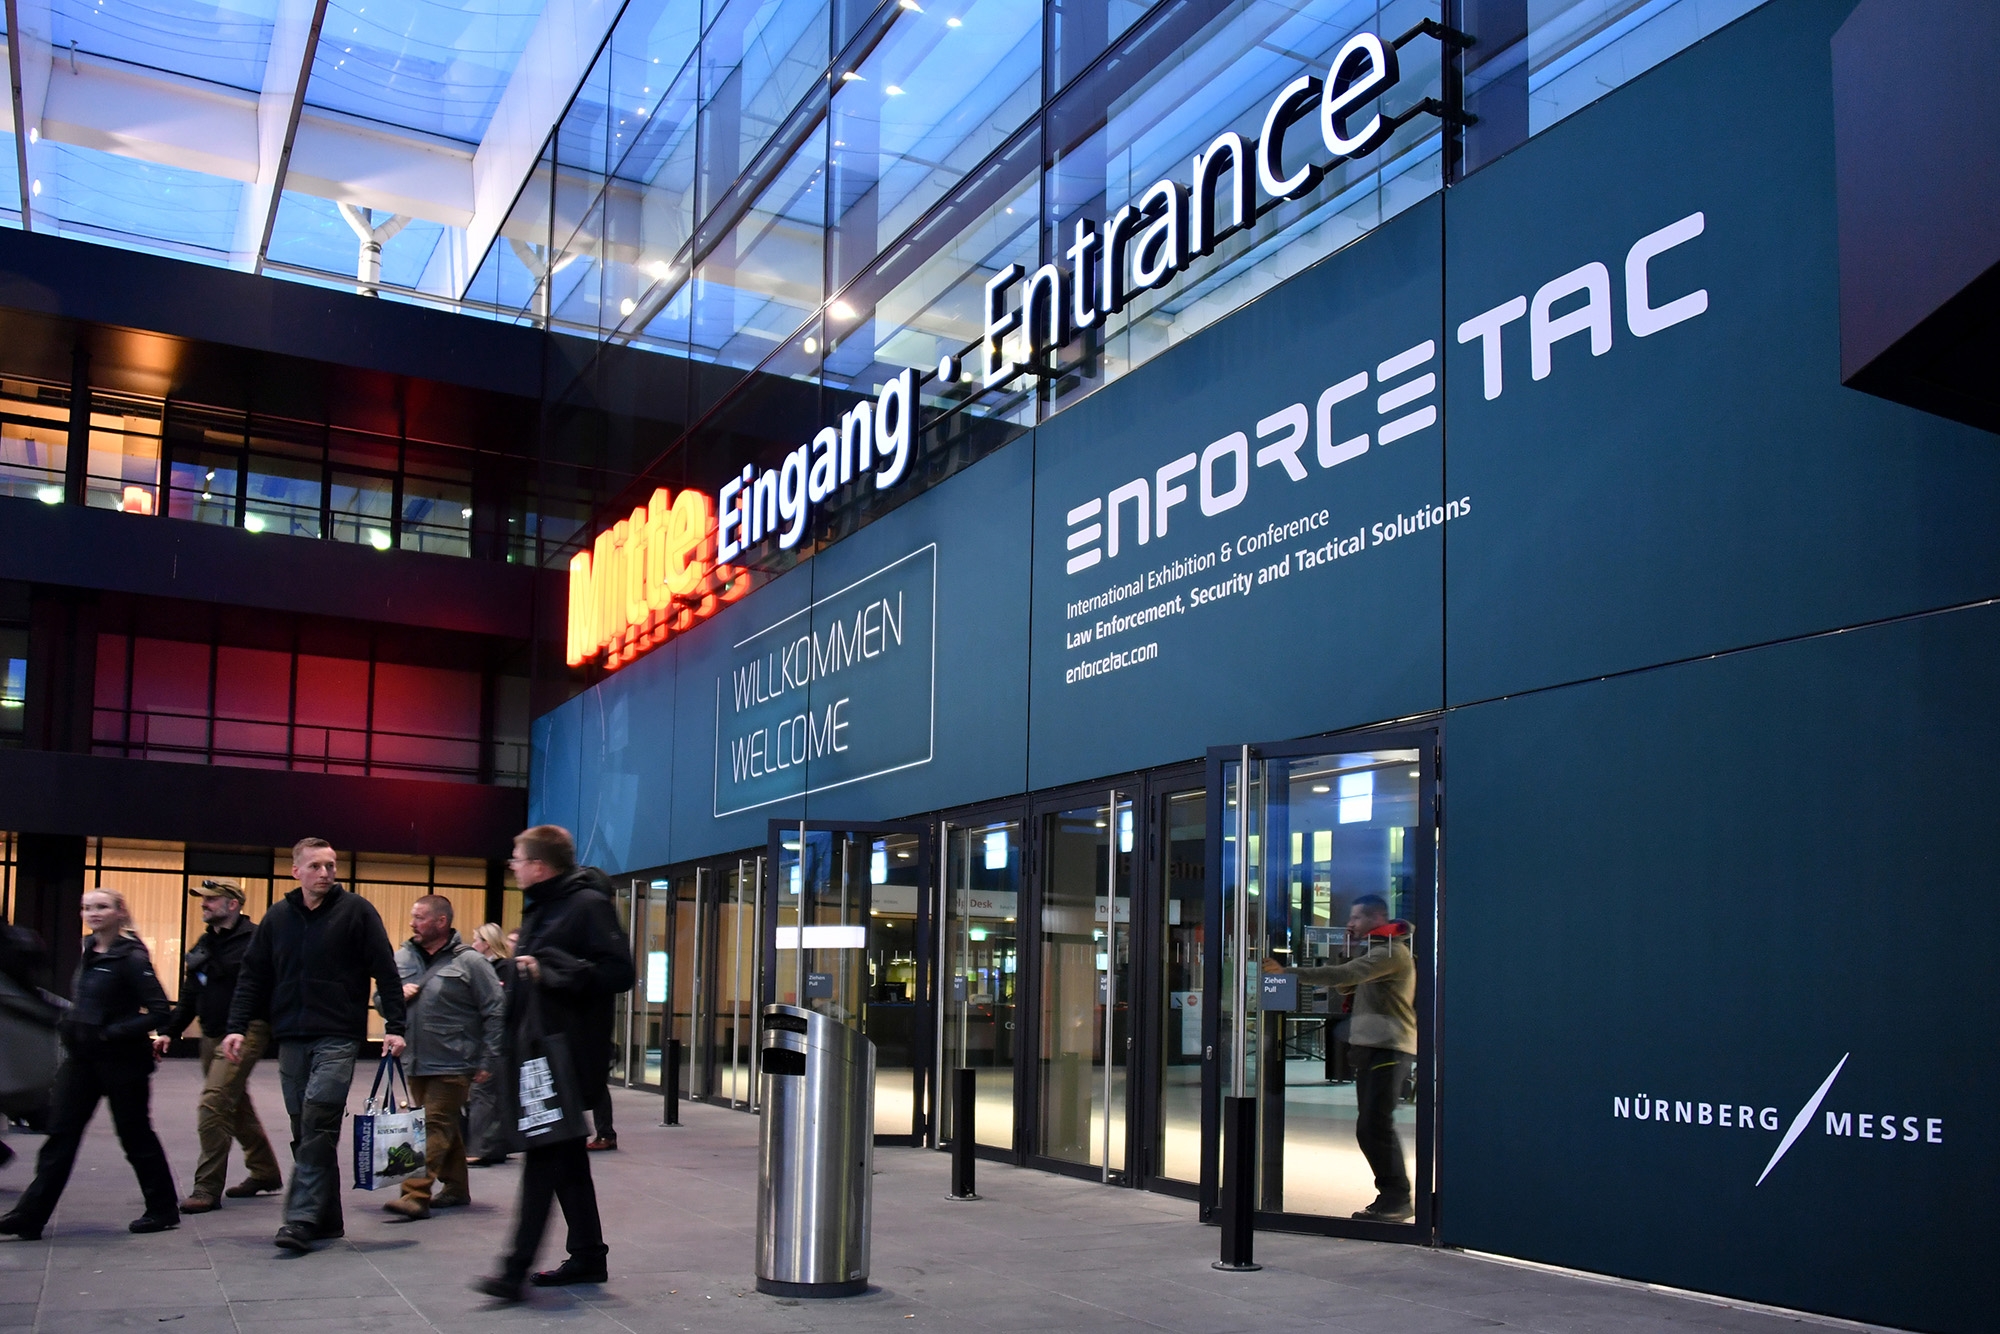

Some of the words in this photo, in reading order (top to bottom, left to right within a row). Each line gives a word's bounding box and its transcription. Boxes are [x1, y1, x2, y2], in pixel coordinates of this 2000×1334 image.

[718, 367, 914, 565] Eingang
[981, 32, 1392, 388] Entrance
[1066, 339, 1438, 575] ENFORCE
[1457, 211, 1708, 401] TAC
[567, 487, 708, 667] Mitte
[1066, 628, 1092, 650] Law
[1096, 594, 1186, 640] Enforcement,
[1190, 572, 1253, 608] Security
[1258, 554, 1290, 585] and
[1295, 527, 1365, 571] Tactical
[1371, 495, 1471, 546] Solutions
[1067, 574, 1144, 619] International
[1148, 552, 1216, 590] Exhibition
[1220, 542, 1232, 562] &
[1236, 509, 1329, 556] Conference
[733, 591, 902, 710] WILLKOMMEN
[1066, 642, 1158, 684] enforcetac.com
[731, 698, 849, 783] WELCOME
[970, 898, 993, 909] Desk
[1613, 1093, 1779, 1131] NÜRNBERG
[1825, 1111, 1943, 1144] MESSE
